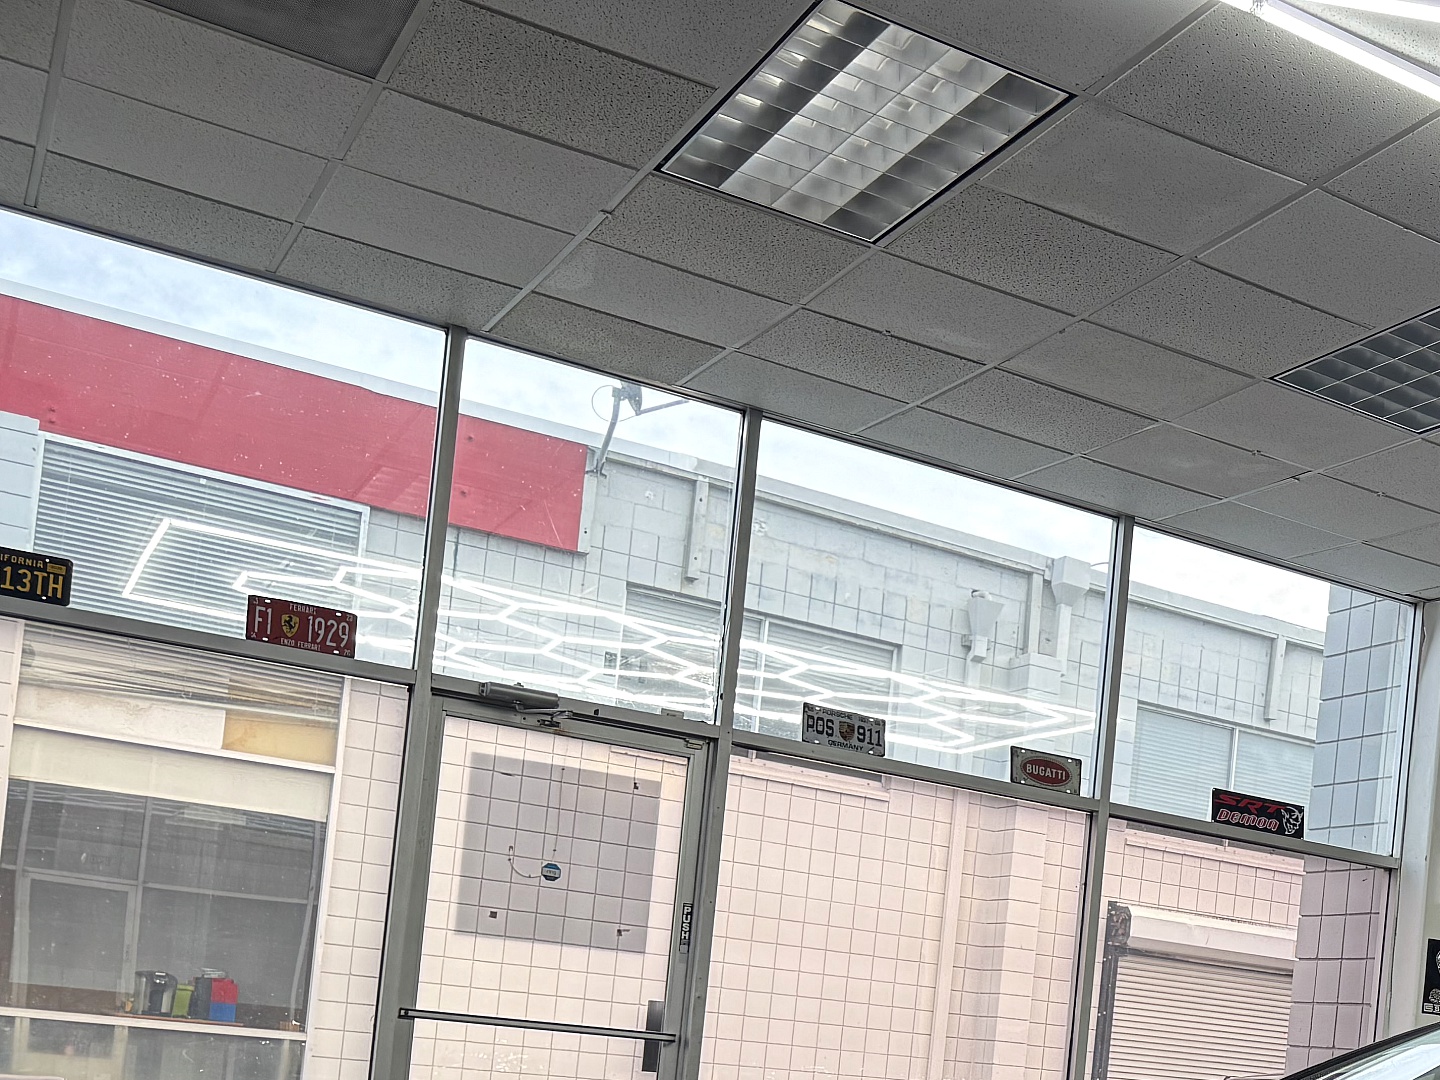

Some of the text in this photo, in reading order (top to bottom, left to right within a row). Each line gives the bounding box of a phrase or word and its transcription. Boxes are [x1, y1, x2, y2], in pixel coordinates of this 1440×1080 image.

[0, 565, 64, 599] 13TH
[289, 602, 317, 615] FERRARI
[254, 605, 349, 648] F1 1929
[280, 638, 321, 651] ENZO FERRARI
[822, 708, 853, 721] PORSCHE
[827, 739, 864, 752] GERMANY
[856, 725, 883, 748] 911
[1026, 763, 1066, 781] BUGATTI
[1214, 794, 1286, 814] SRT
[1216, 808, 1279, 832] DEMON
[682, 906, 692, 940] PUSH
